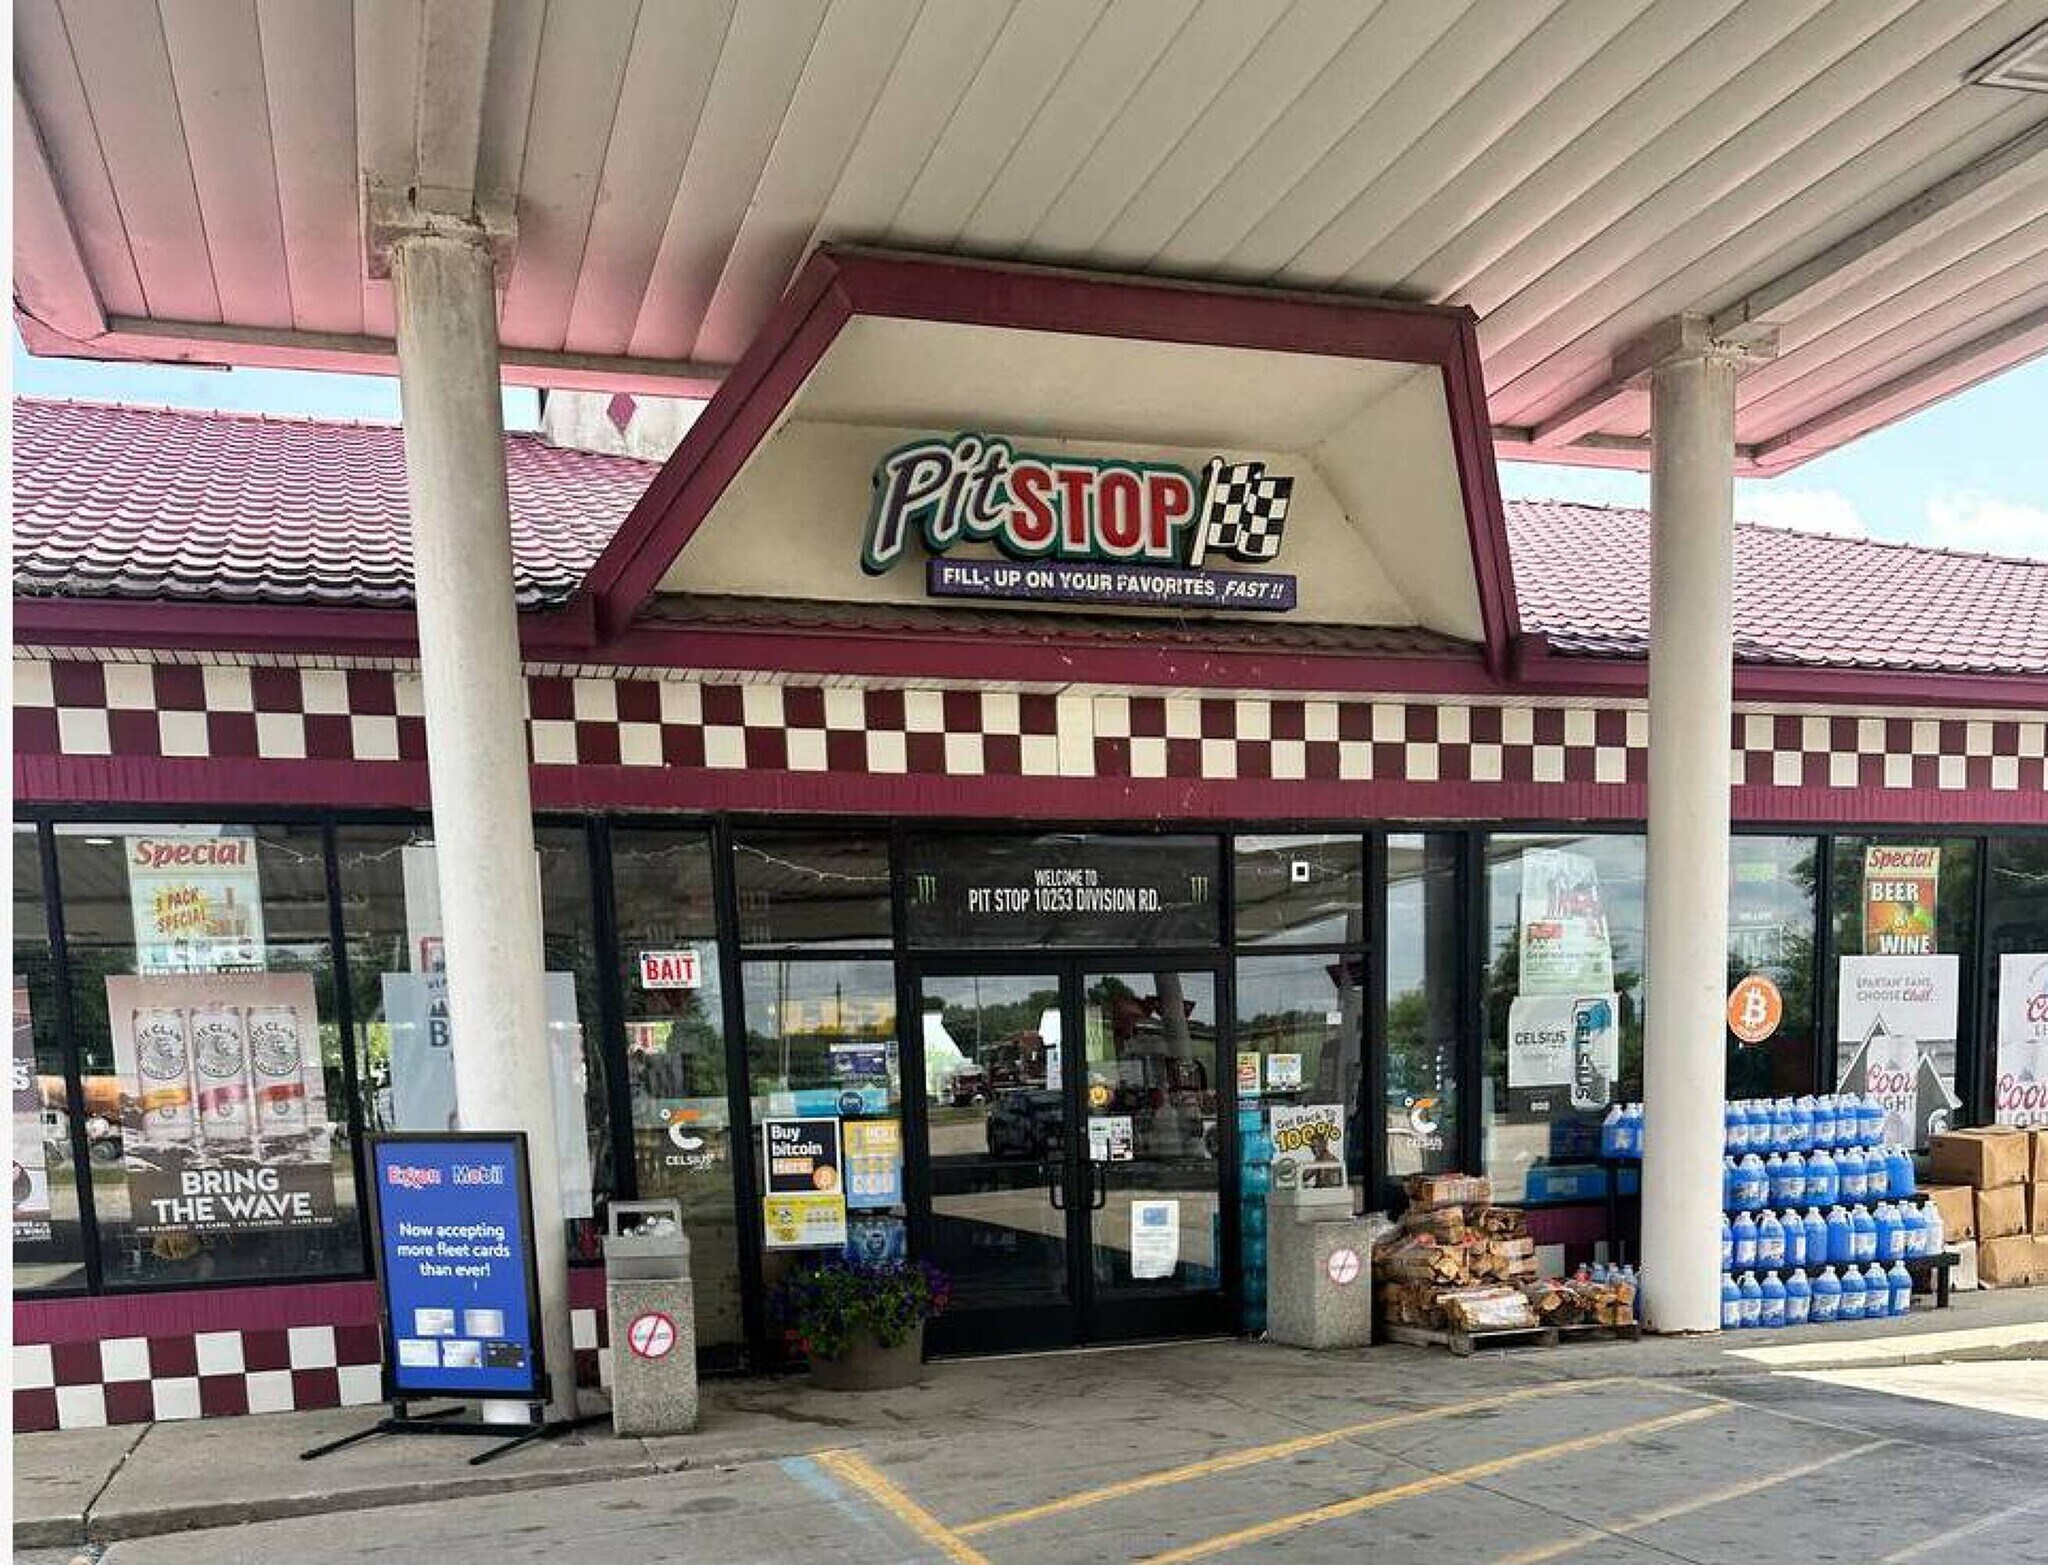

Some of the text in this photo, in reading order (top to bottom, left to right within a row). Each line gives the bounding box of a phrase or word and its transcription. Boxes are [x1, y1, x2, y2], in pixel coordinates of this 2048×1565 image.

[1008, 463, 1194, 555] STOP
[1026, 571, 1054, 589] ON
[1060, 572, 1112, 591] YOUR
[134, 839, 247, 869] Special
[1869, 849, 1934, 869] Special
[1034, 869, 1097, 886] WELCOME TO
[167, 887, 200, 908] PACK
[969, 888, 1161, 911] PIT STOP 10253 DIVISION RD.
[1871, 883, 1919, 901] BEER
[1880, 934, 1930, 954] WINE
[647, 958, 694, 980] BAIT
[1515, 1032, 1566, 1045] CELSIUS
[771, 1125, 800, 1141] Buy
[771, 1141, 822, 1156] bitcoin
[181, 1168, 279, 1195] BRING
[151, 1192, 313, 1223] THE WAVE
[399, 1222, 505, 1241] Now accepting
[398, 1241, 510, 1257] more fleet cards
[420, 1262, 491, 1276] than ever!
